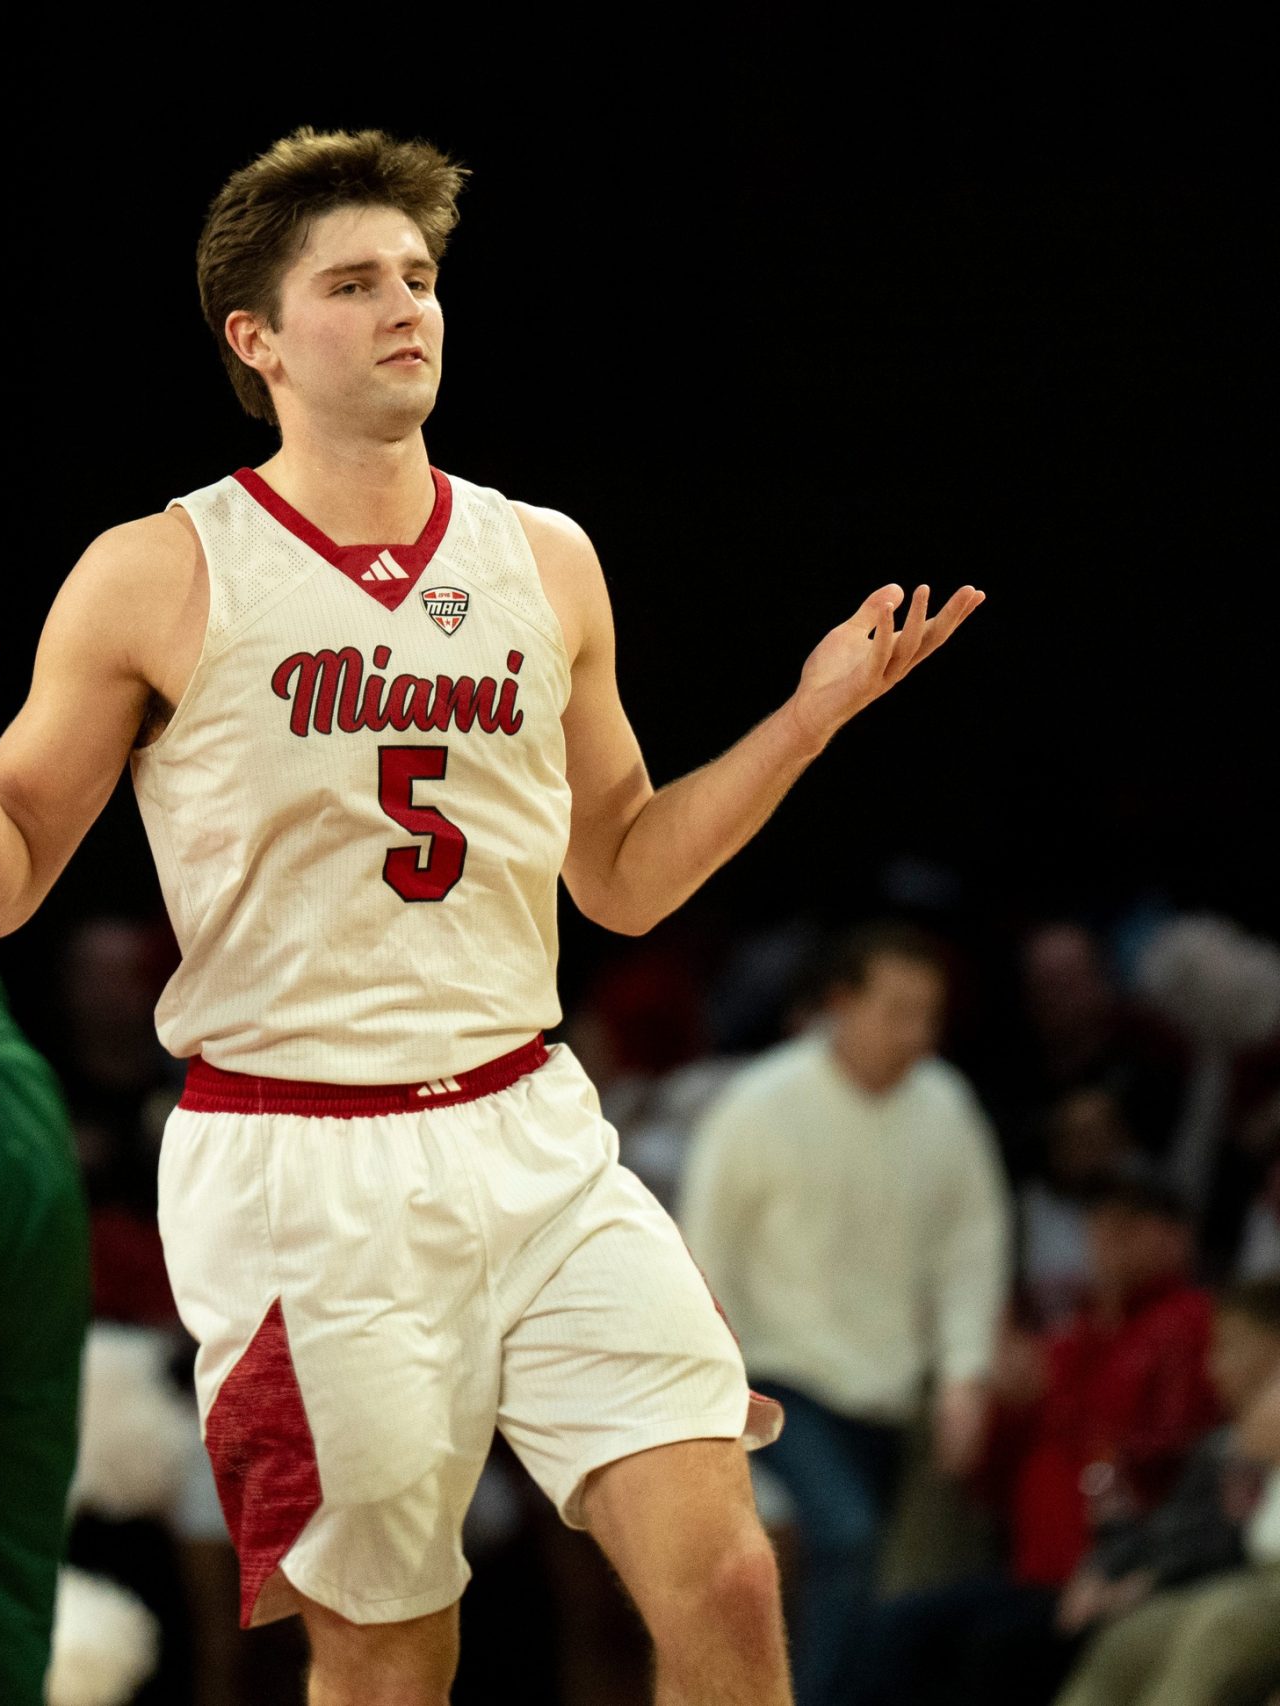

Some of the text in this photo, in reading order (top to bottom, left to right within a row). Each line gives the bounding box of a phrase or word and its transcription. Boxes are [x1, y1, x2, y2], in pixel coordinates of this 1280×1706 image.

[426, 602, 468, 615] MAC
[271, 645, 524, 737] Miami
[378, 745, 467, 903] 5
